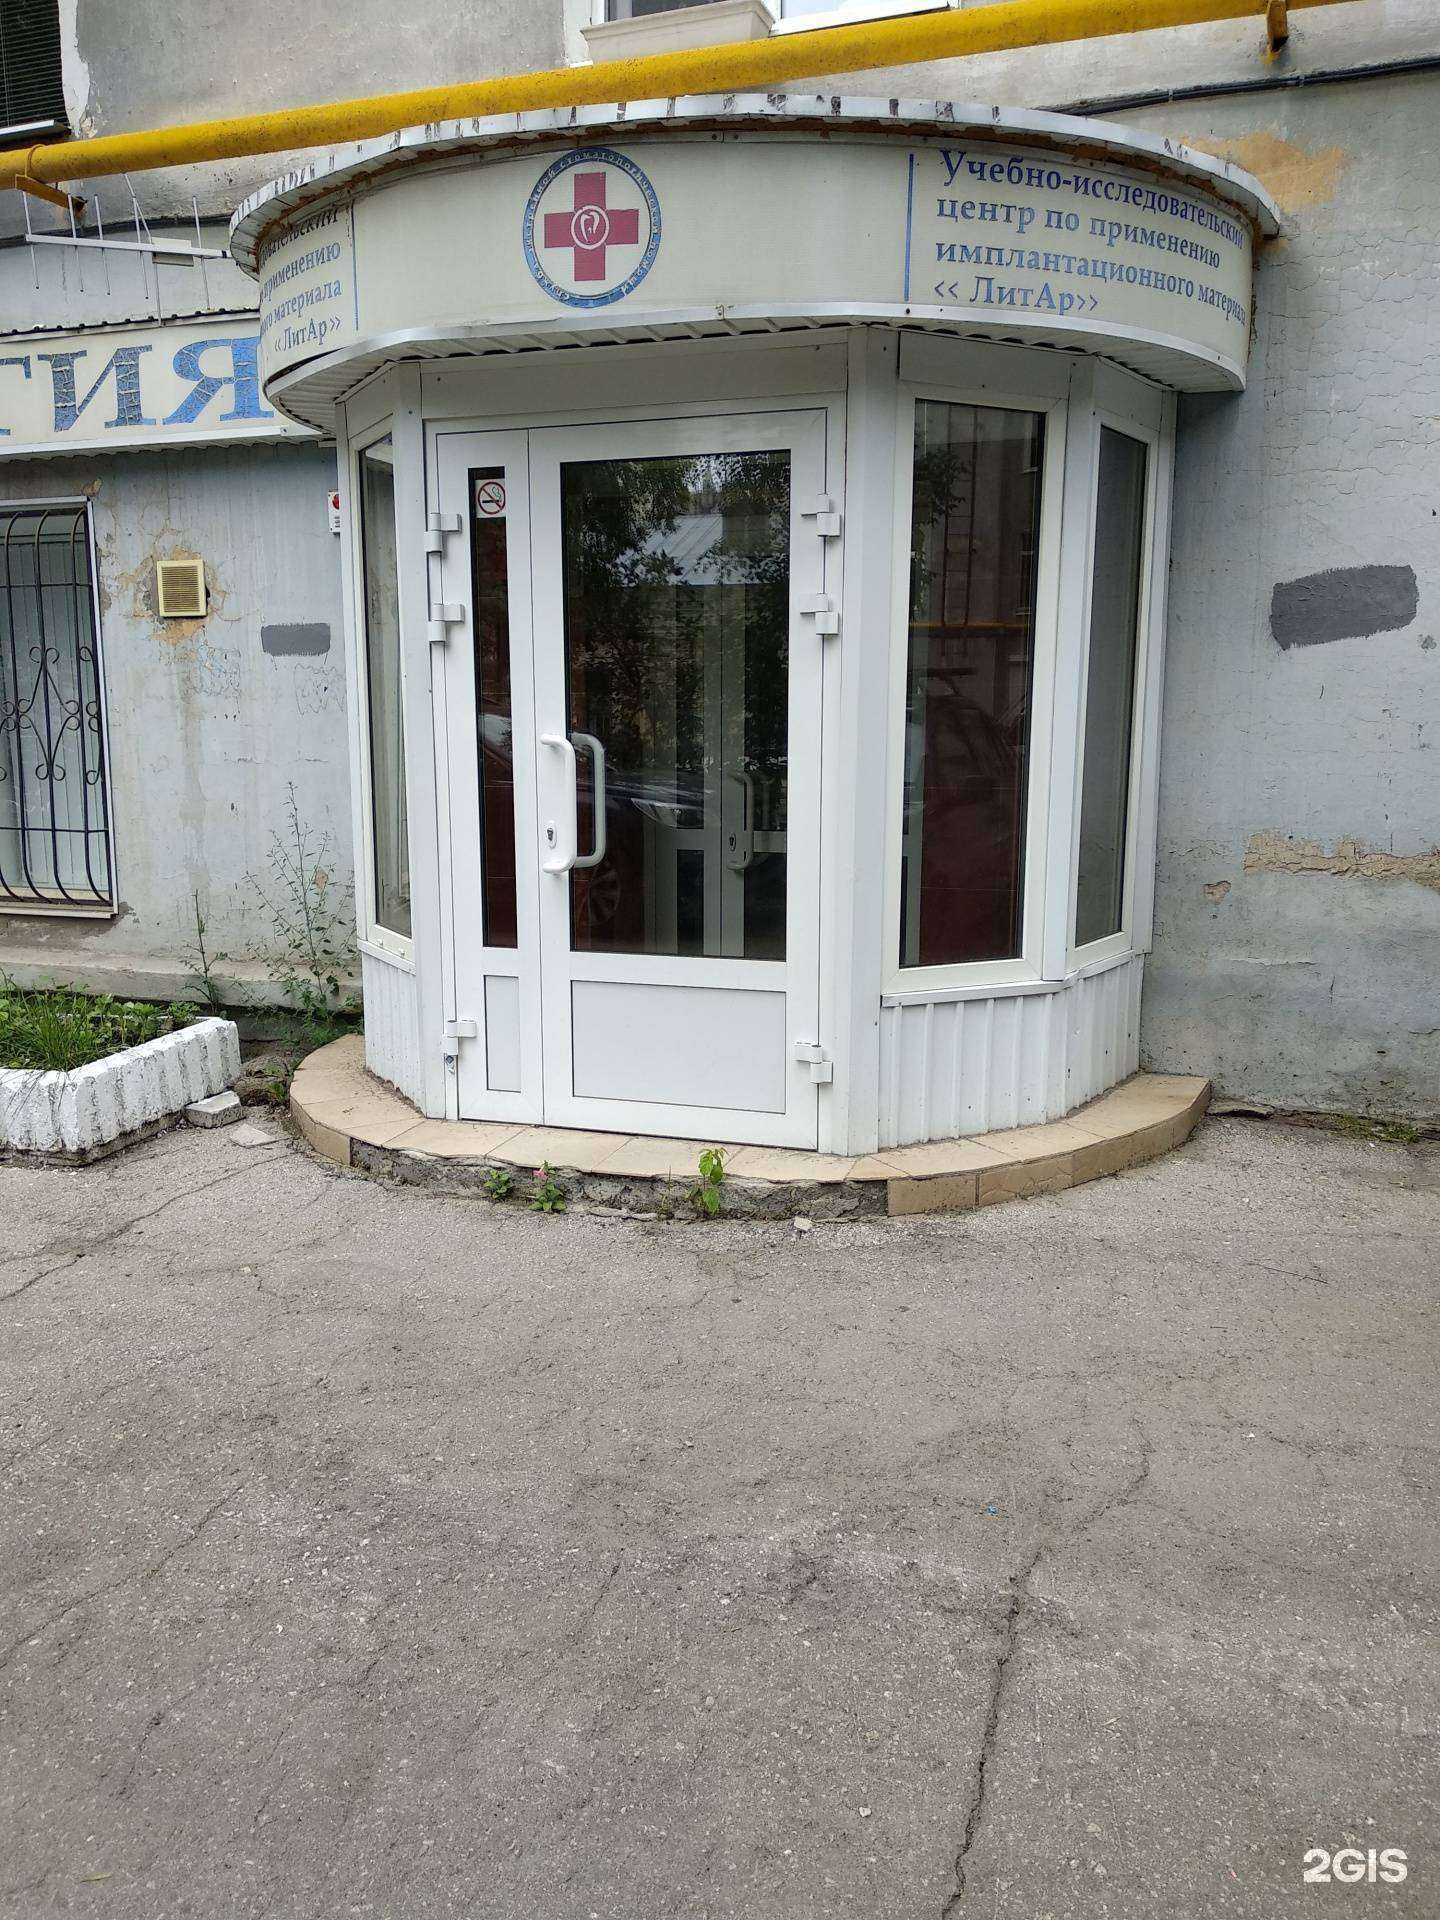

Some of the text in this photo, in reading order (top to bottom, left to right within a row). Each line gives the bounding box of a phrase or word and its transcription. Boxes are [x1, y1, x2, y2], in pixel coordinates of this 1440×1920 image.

[939, 149, 1244, 250] Учебно-исследовательский
[937, 198, 1220, 268] центр по применению
[936, 242, 1194, 298] имплантационного
[274, 280, 342, 324] материала
